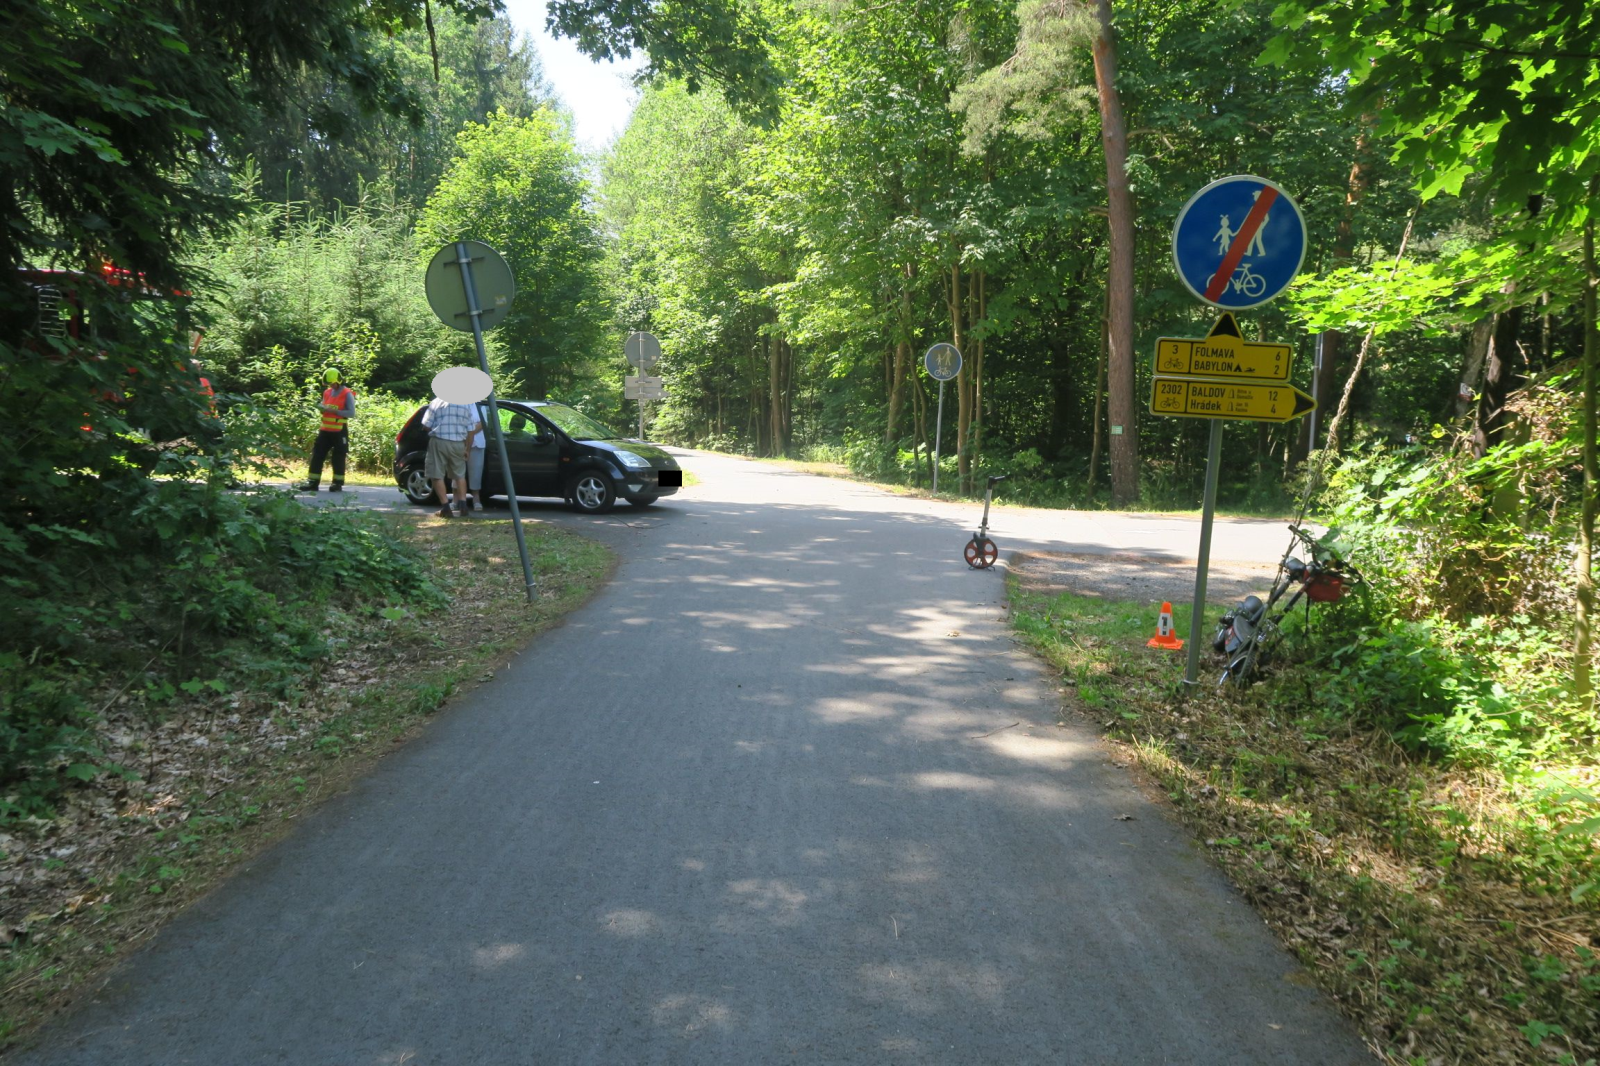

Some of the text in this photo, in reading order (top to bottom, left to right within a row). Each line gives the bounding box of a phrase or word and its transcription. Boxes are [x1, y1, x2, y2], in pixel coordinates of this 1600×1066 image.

[1172, 345, 1179, 354] 3
[1195, 346, 1281, 361] FOLMAVA 6
[1194, 360, 1280, 375] BABYLON 2
[1161, 384, 1182, 395] 2302
[1191, 386, 1226, 398] BALDOV
[1268, 391, 1279, 401] 12
[1190, 399, 1222, 411] Hrádek
[1270, 404, 1276, 415] 4
